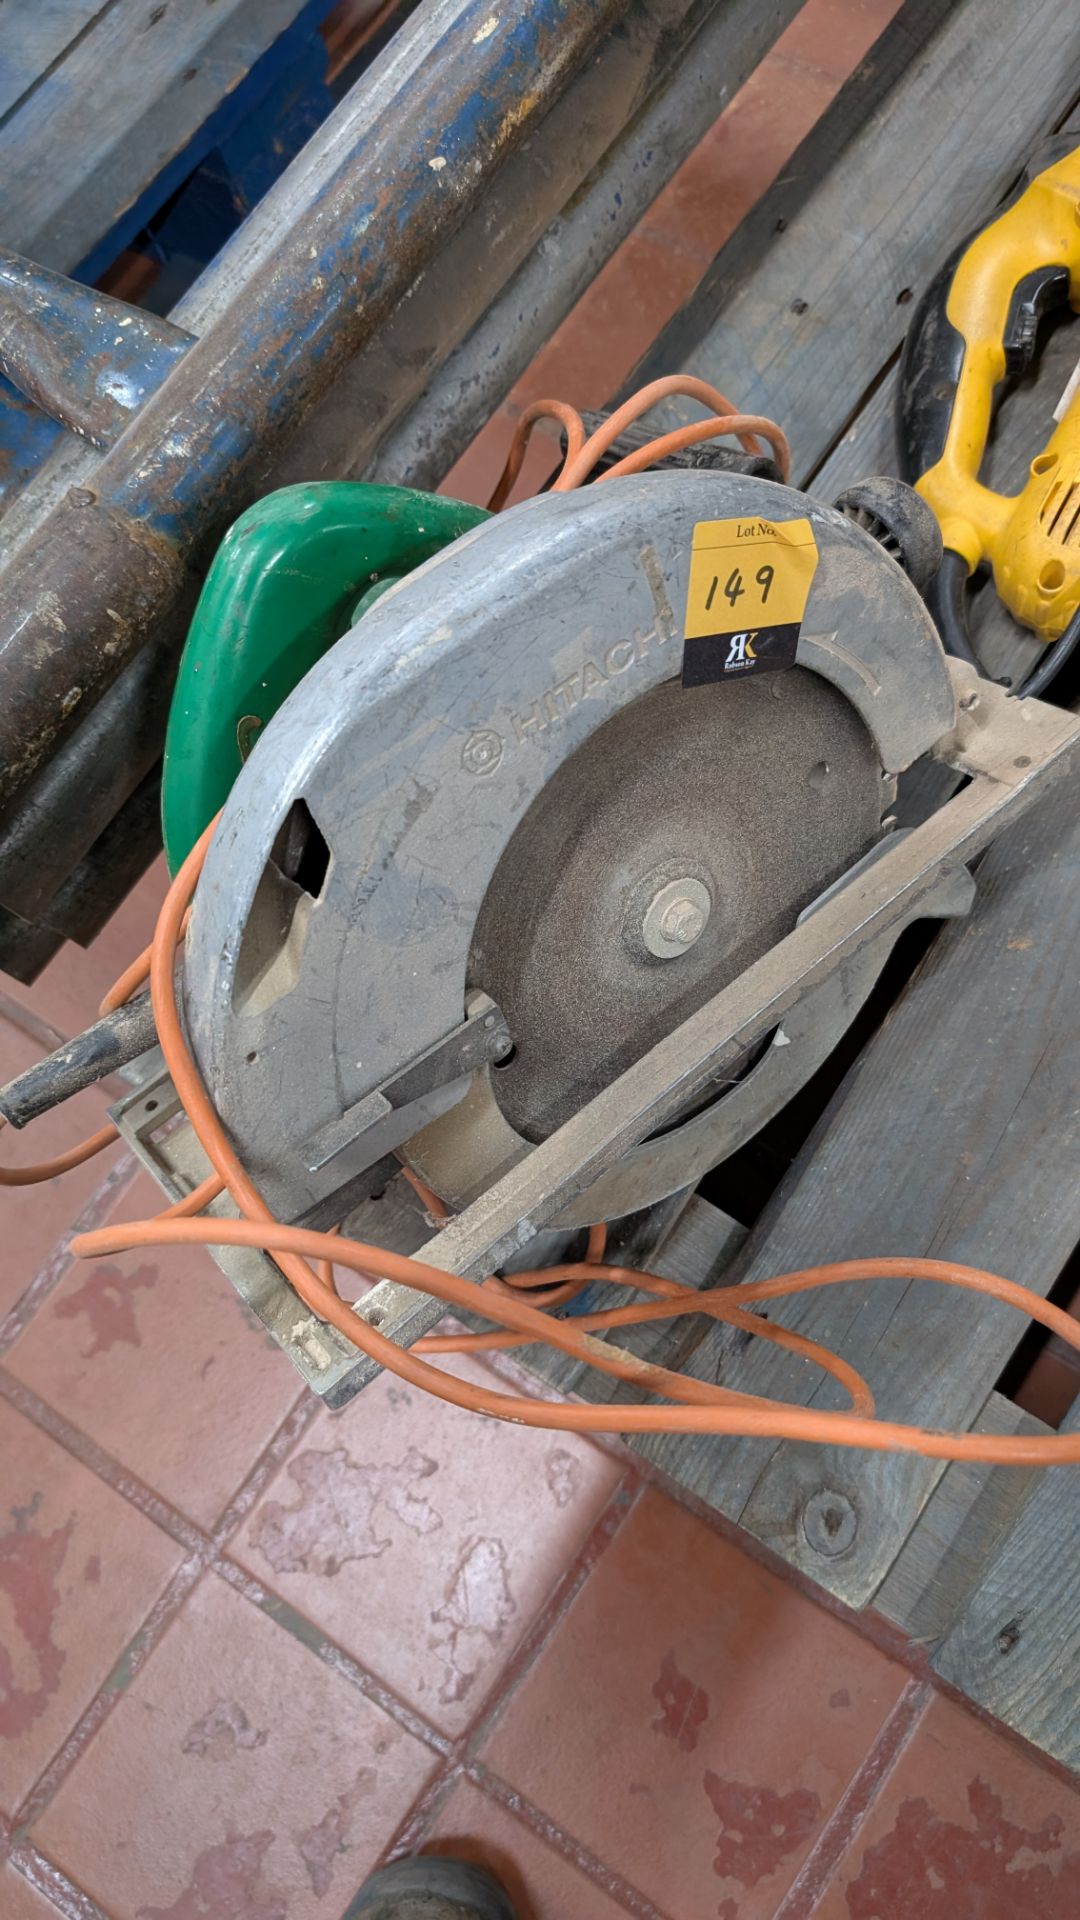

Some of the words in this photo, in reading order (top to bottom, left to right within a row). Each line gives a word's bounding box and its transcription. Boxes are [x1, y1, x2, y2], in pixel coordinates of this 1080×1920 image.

[736, 524, 755, 538] Lot
[758, 523, 777, 537] No.
[705, 565, 775, 611] 149
[510, 611, 679, 745] HITACHI
